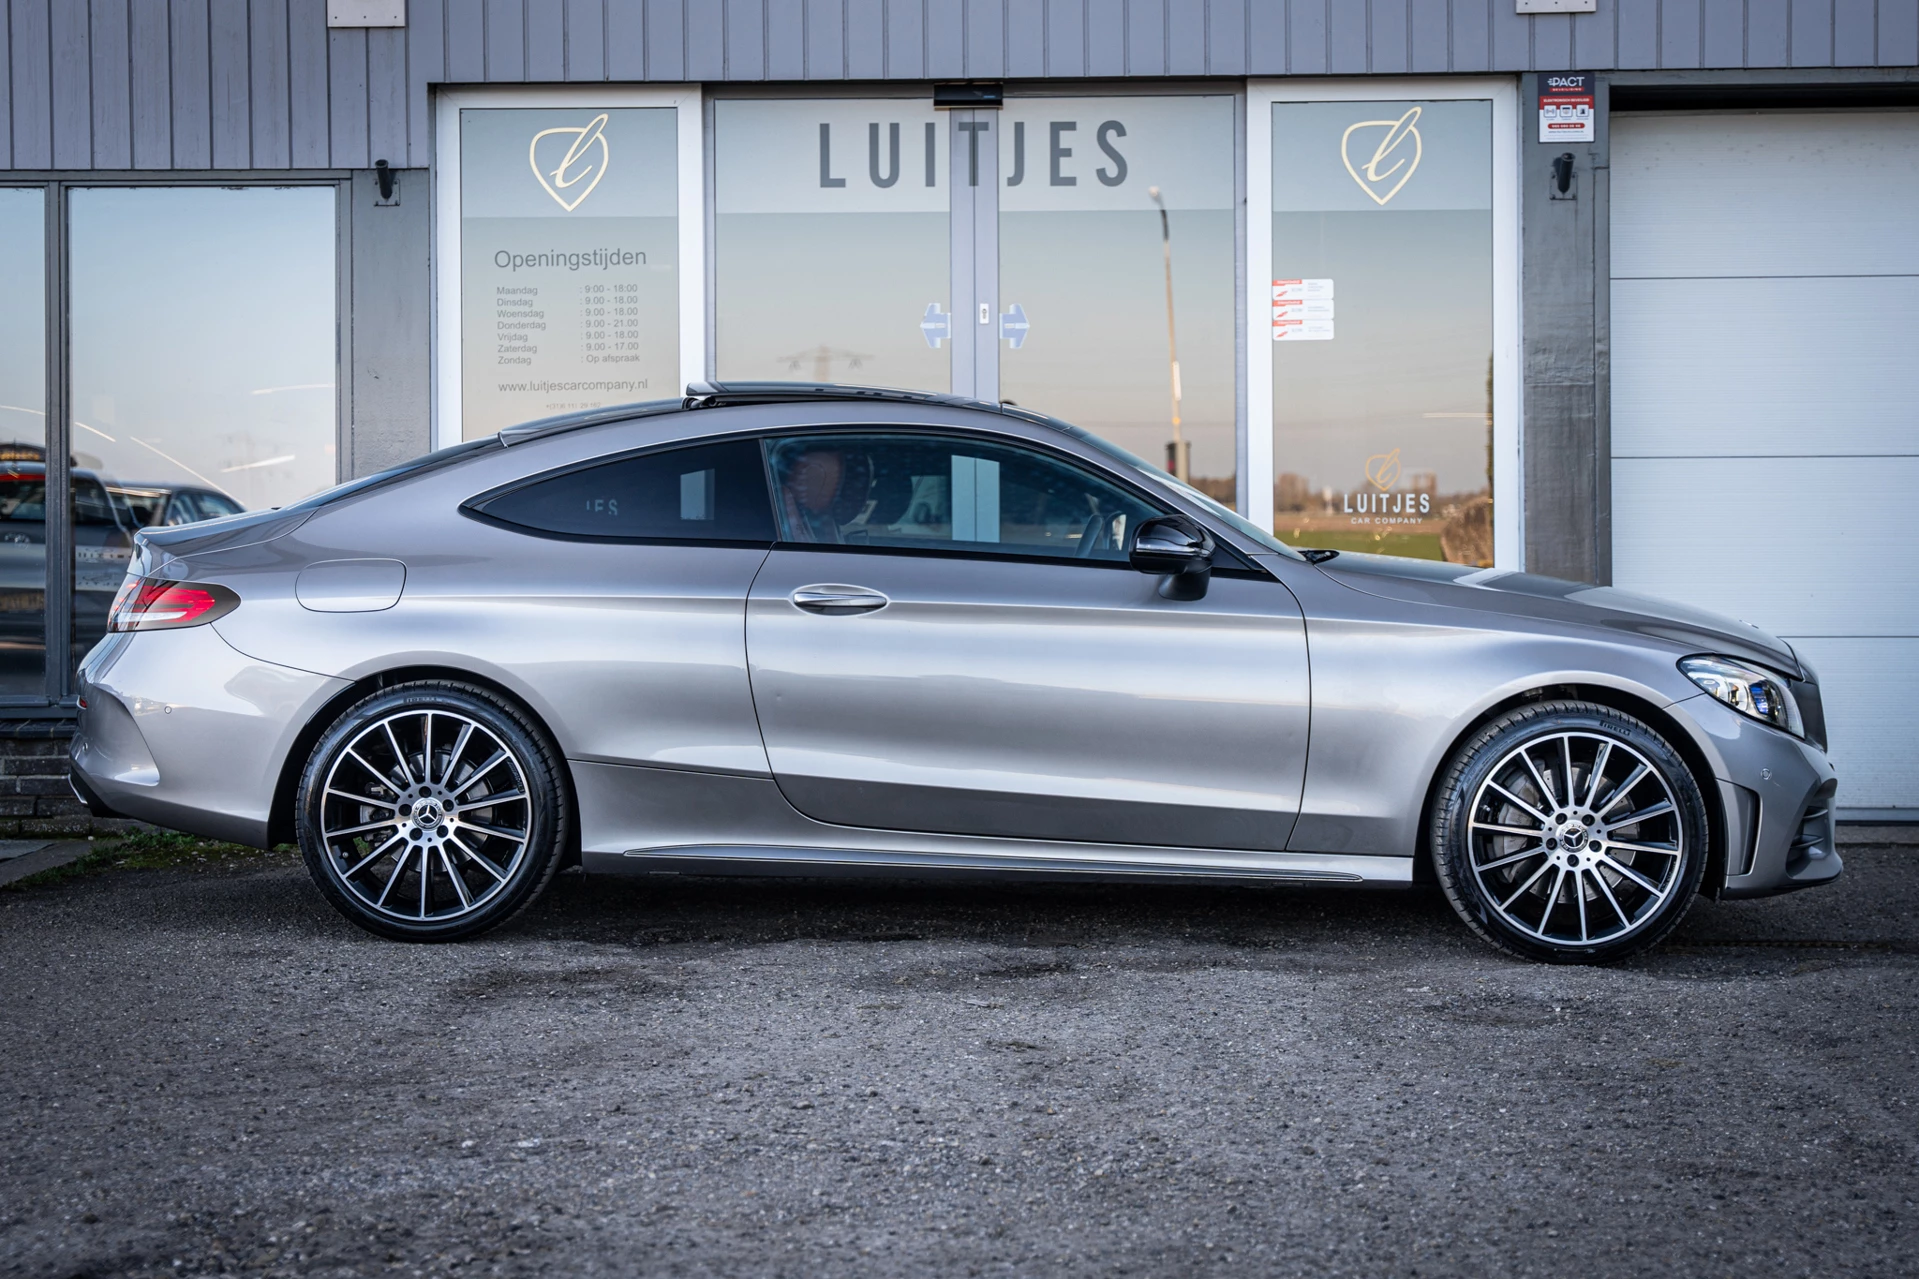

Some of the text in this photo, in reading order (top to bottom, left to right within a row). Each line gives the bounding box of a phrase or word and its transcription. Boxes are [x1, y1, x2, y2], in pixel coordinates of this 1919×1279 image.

[1551, 76, 1585, 87] PACT
[819, 119, 1128, 188] LUITJES
[494, 248, 647, 271] Openingstijden
[496, 286, 538, 296] Maandag
[497, 298, 533, 308] Dinsdag
[497, 309, 544, 319] Woensdag
[497, 321, 546, 331] Donderdag
[497, 333, 528, 343] Vrijdag
[497, 344, 537, 354] Zaterdag
[498, 355, 532, 366] Zondag
[586, 354, 600, 364] Op
[602, 353, 640, 363] afspraak
[498, 379, 648, 393] www.luitjescarcompany.nl
[1343, 493, 1430, 513] LUITJES
